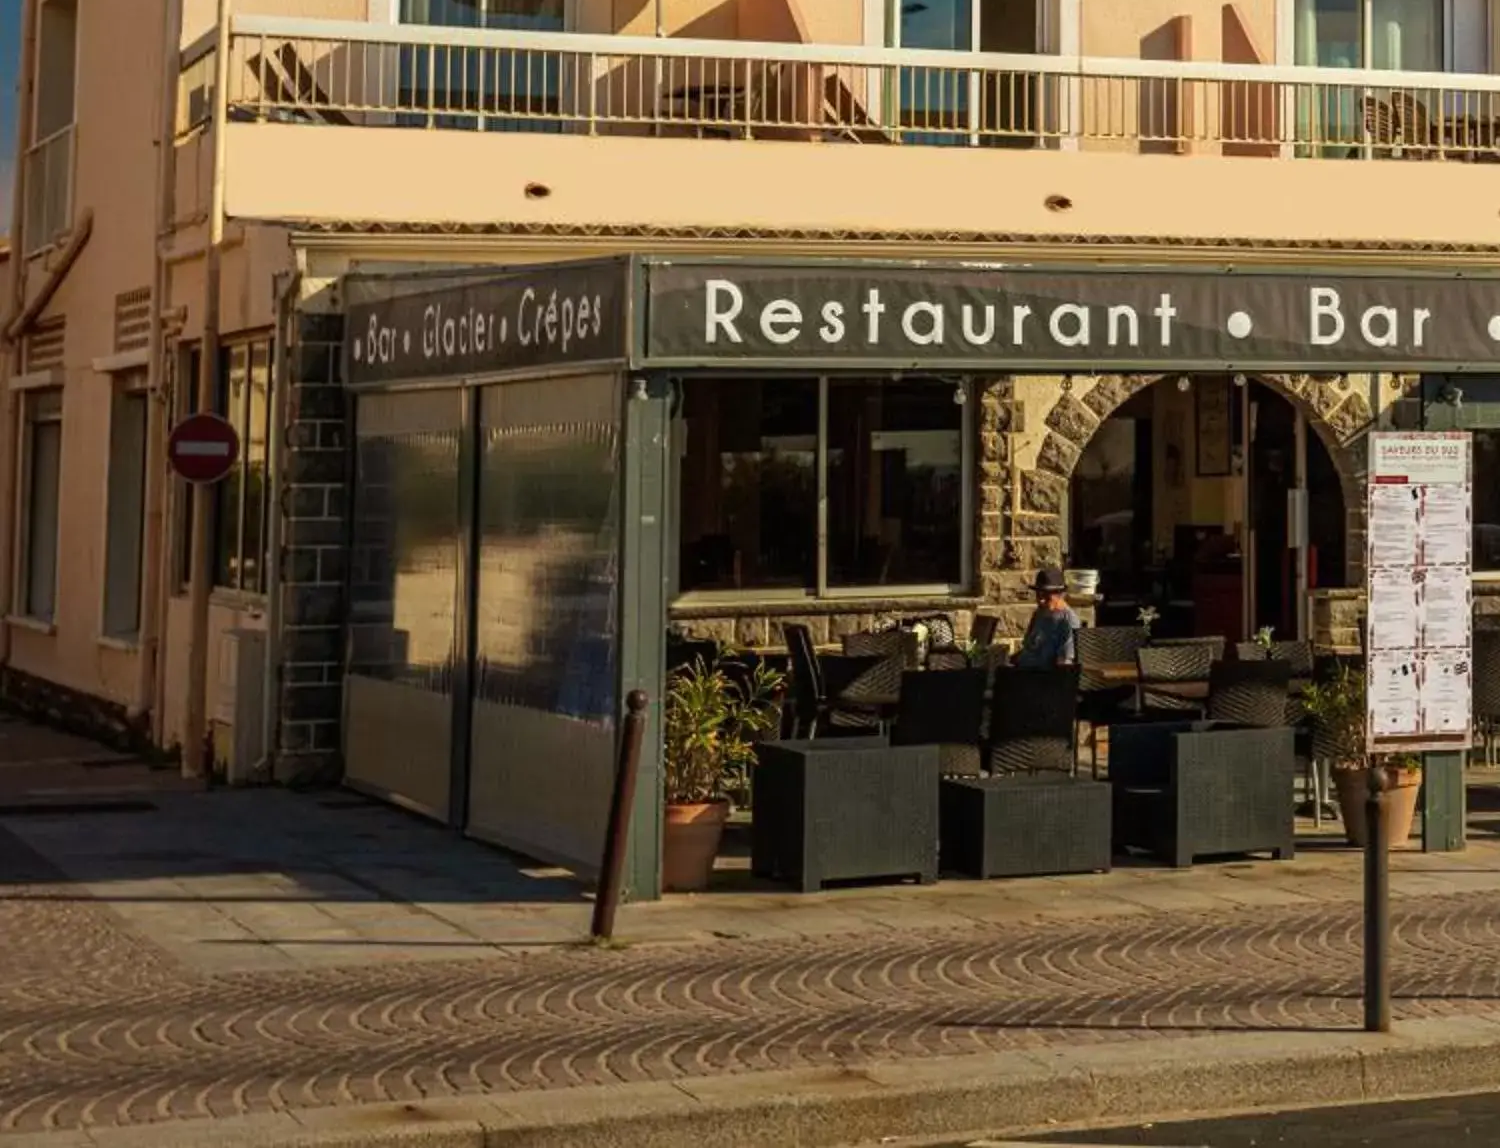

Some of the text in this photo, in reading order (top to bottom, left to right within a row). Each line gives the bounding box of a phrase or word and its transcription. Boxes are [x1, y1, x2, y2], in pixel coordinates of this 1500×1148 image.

[367, 312, 397, 365] Bar
[423, 302, 494, 359] Glacier
[703, 279, 1176, 346] Restaurant
[1310, 287, 1430, 346] Bar
